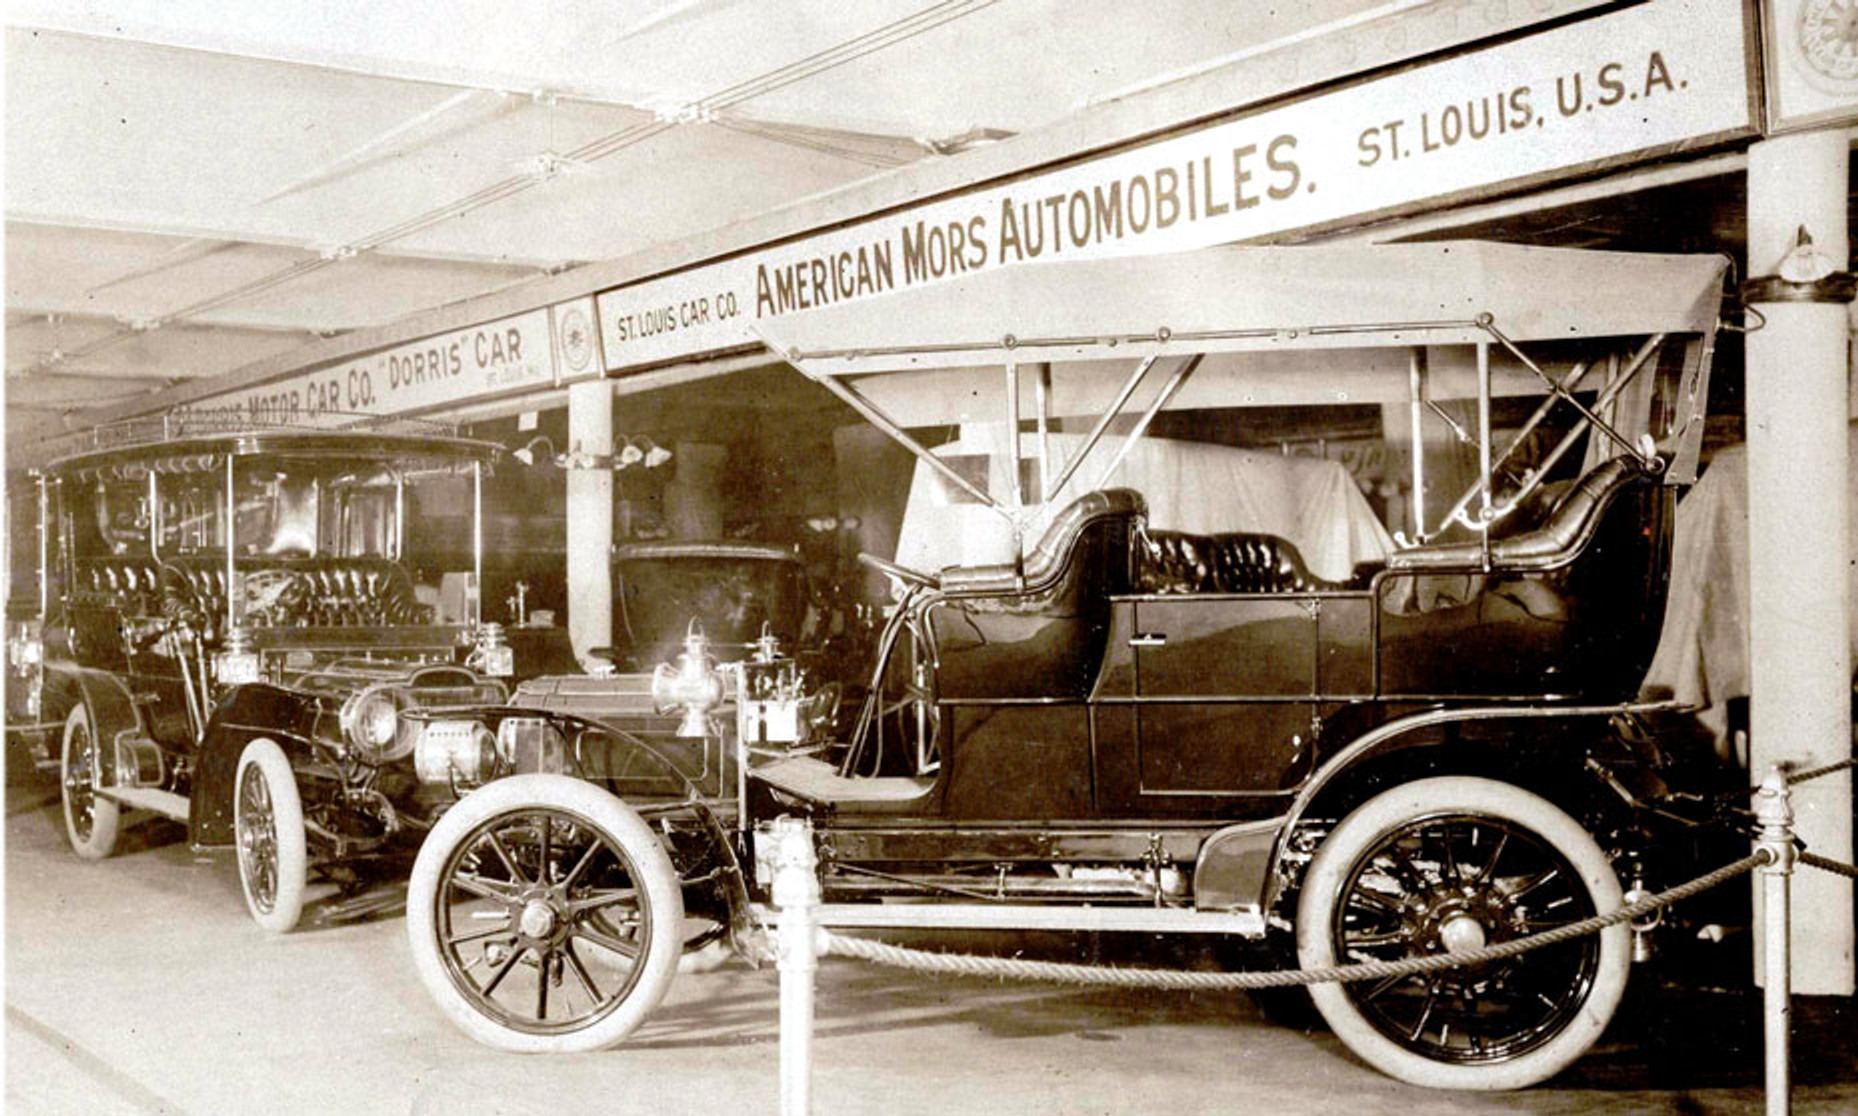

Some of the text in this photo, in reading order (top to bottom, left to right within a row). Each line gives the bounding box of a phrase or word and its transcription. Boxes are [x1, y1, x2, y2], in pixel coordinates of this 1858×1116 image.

[618, 316, 636, 342] ST.
[640, 306, 677, 338] LOUIS
[680, 299, 710, 328] CAR
[716, 292, 741, 320] CO.
[755, 239, 894, 319] AMERICAN
[901, 216, 988, 286] MORS
[999, 134, 1316, 264] AUTOMOBILES.
[1357, 119, 1410, 167] ST.
[1556, 50, 1688, 118] U.S.A.
[248, 389, 300, 426] MOTOR
[307, 380, 340, 419] CAR
[348, 368, 376, 410] CO.
[475, 329, 521, 368] CAR
